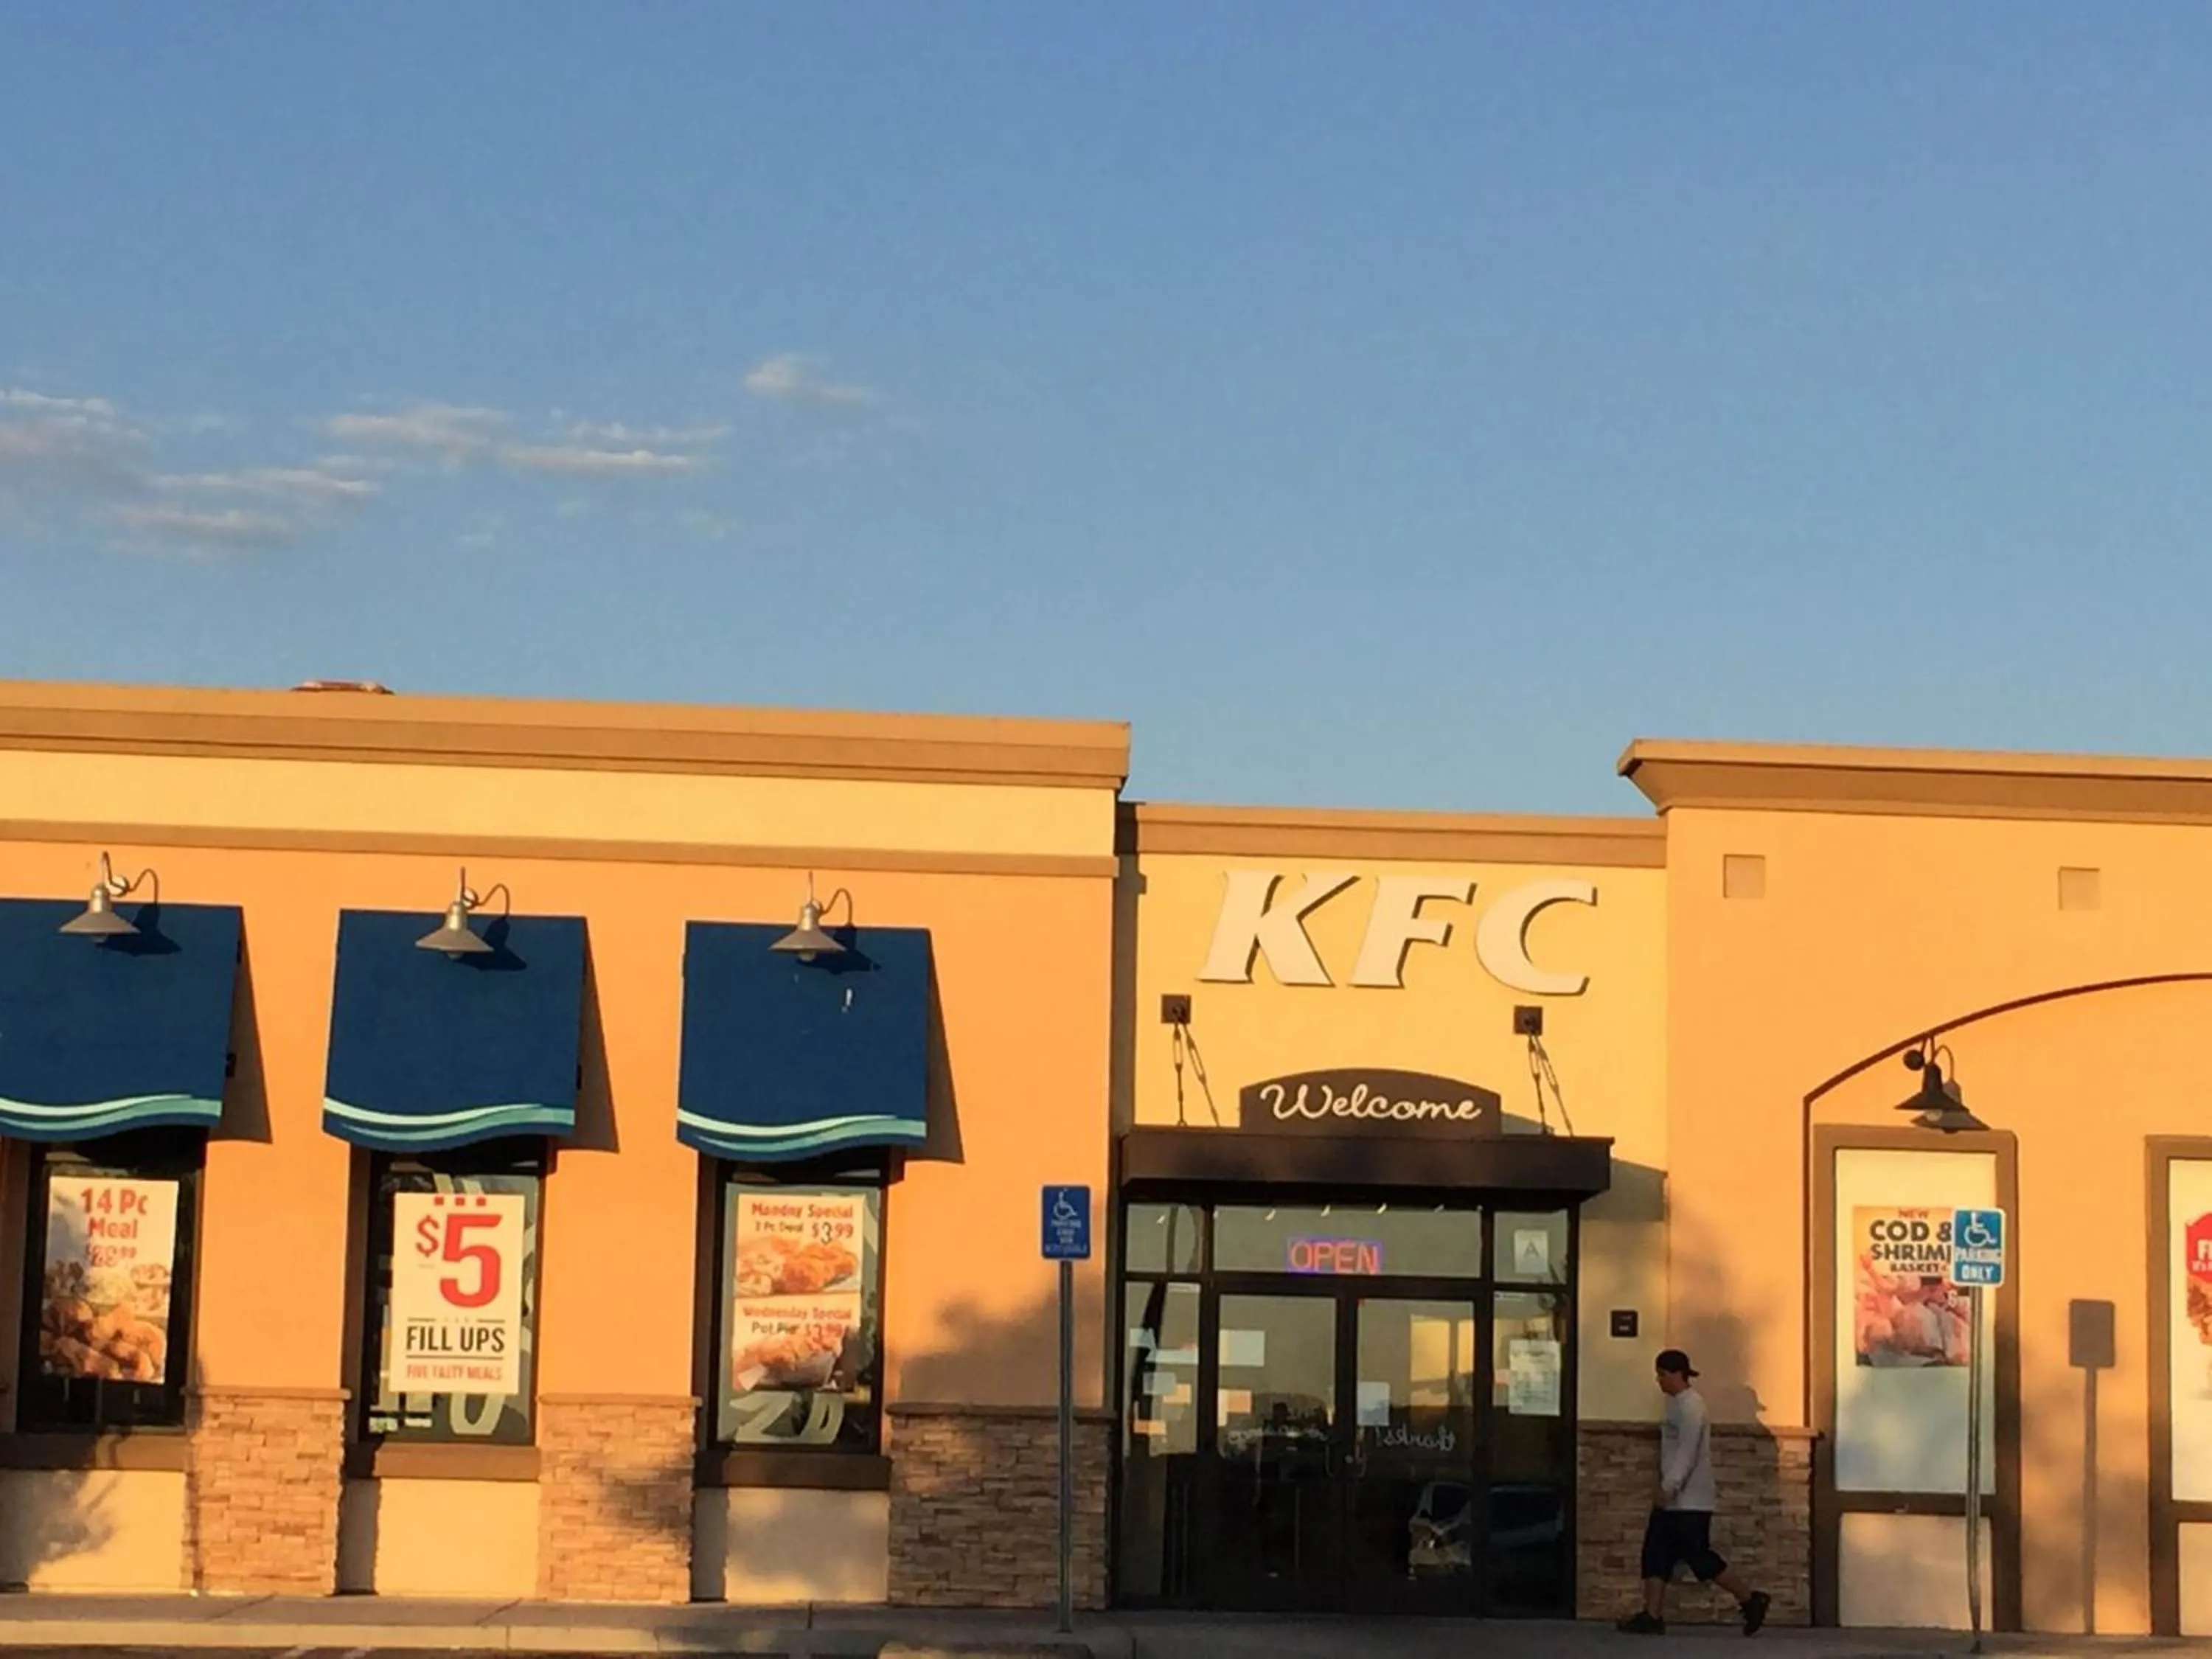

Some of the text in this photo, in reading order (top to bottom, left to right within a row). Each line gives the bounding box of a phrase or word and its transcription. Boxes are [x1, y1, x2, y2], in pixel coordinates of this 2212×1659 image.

[1194, 870, 1598, 996] KFC
[1260, 1083, 1483, 1121] Welcome
[80, 1186, 148, 1215] 14 Pc
[751, 1203, 853, 1219] Monday Special
[1899, 1208, 1929, 1218] NEW
[88, 1217, 138, 1239] Meal
[1870, 1220, 1952, 1242] COD &
[1290, 1240, 1378, 1275] OPEN
[1523, 1241, 1540, 1258] A
[1955, 1247, 2000, 1262] PARKING
[416, 1214, 502, 1308] $5
[1961, 1264, 1995, 1281] ONLY
[743, 1306, 852, 1319] Wednesday Special
[752, 1321, 773, 1335] Pot
[406, 1326, 505, 1352] FILL UPS
[406, 1364, 503, 1381] FIVE TASTY MEALS
